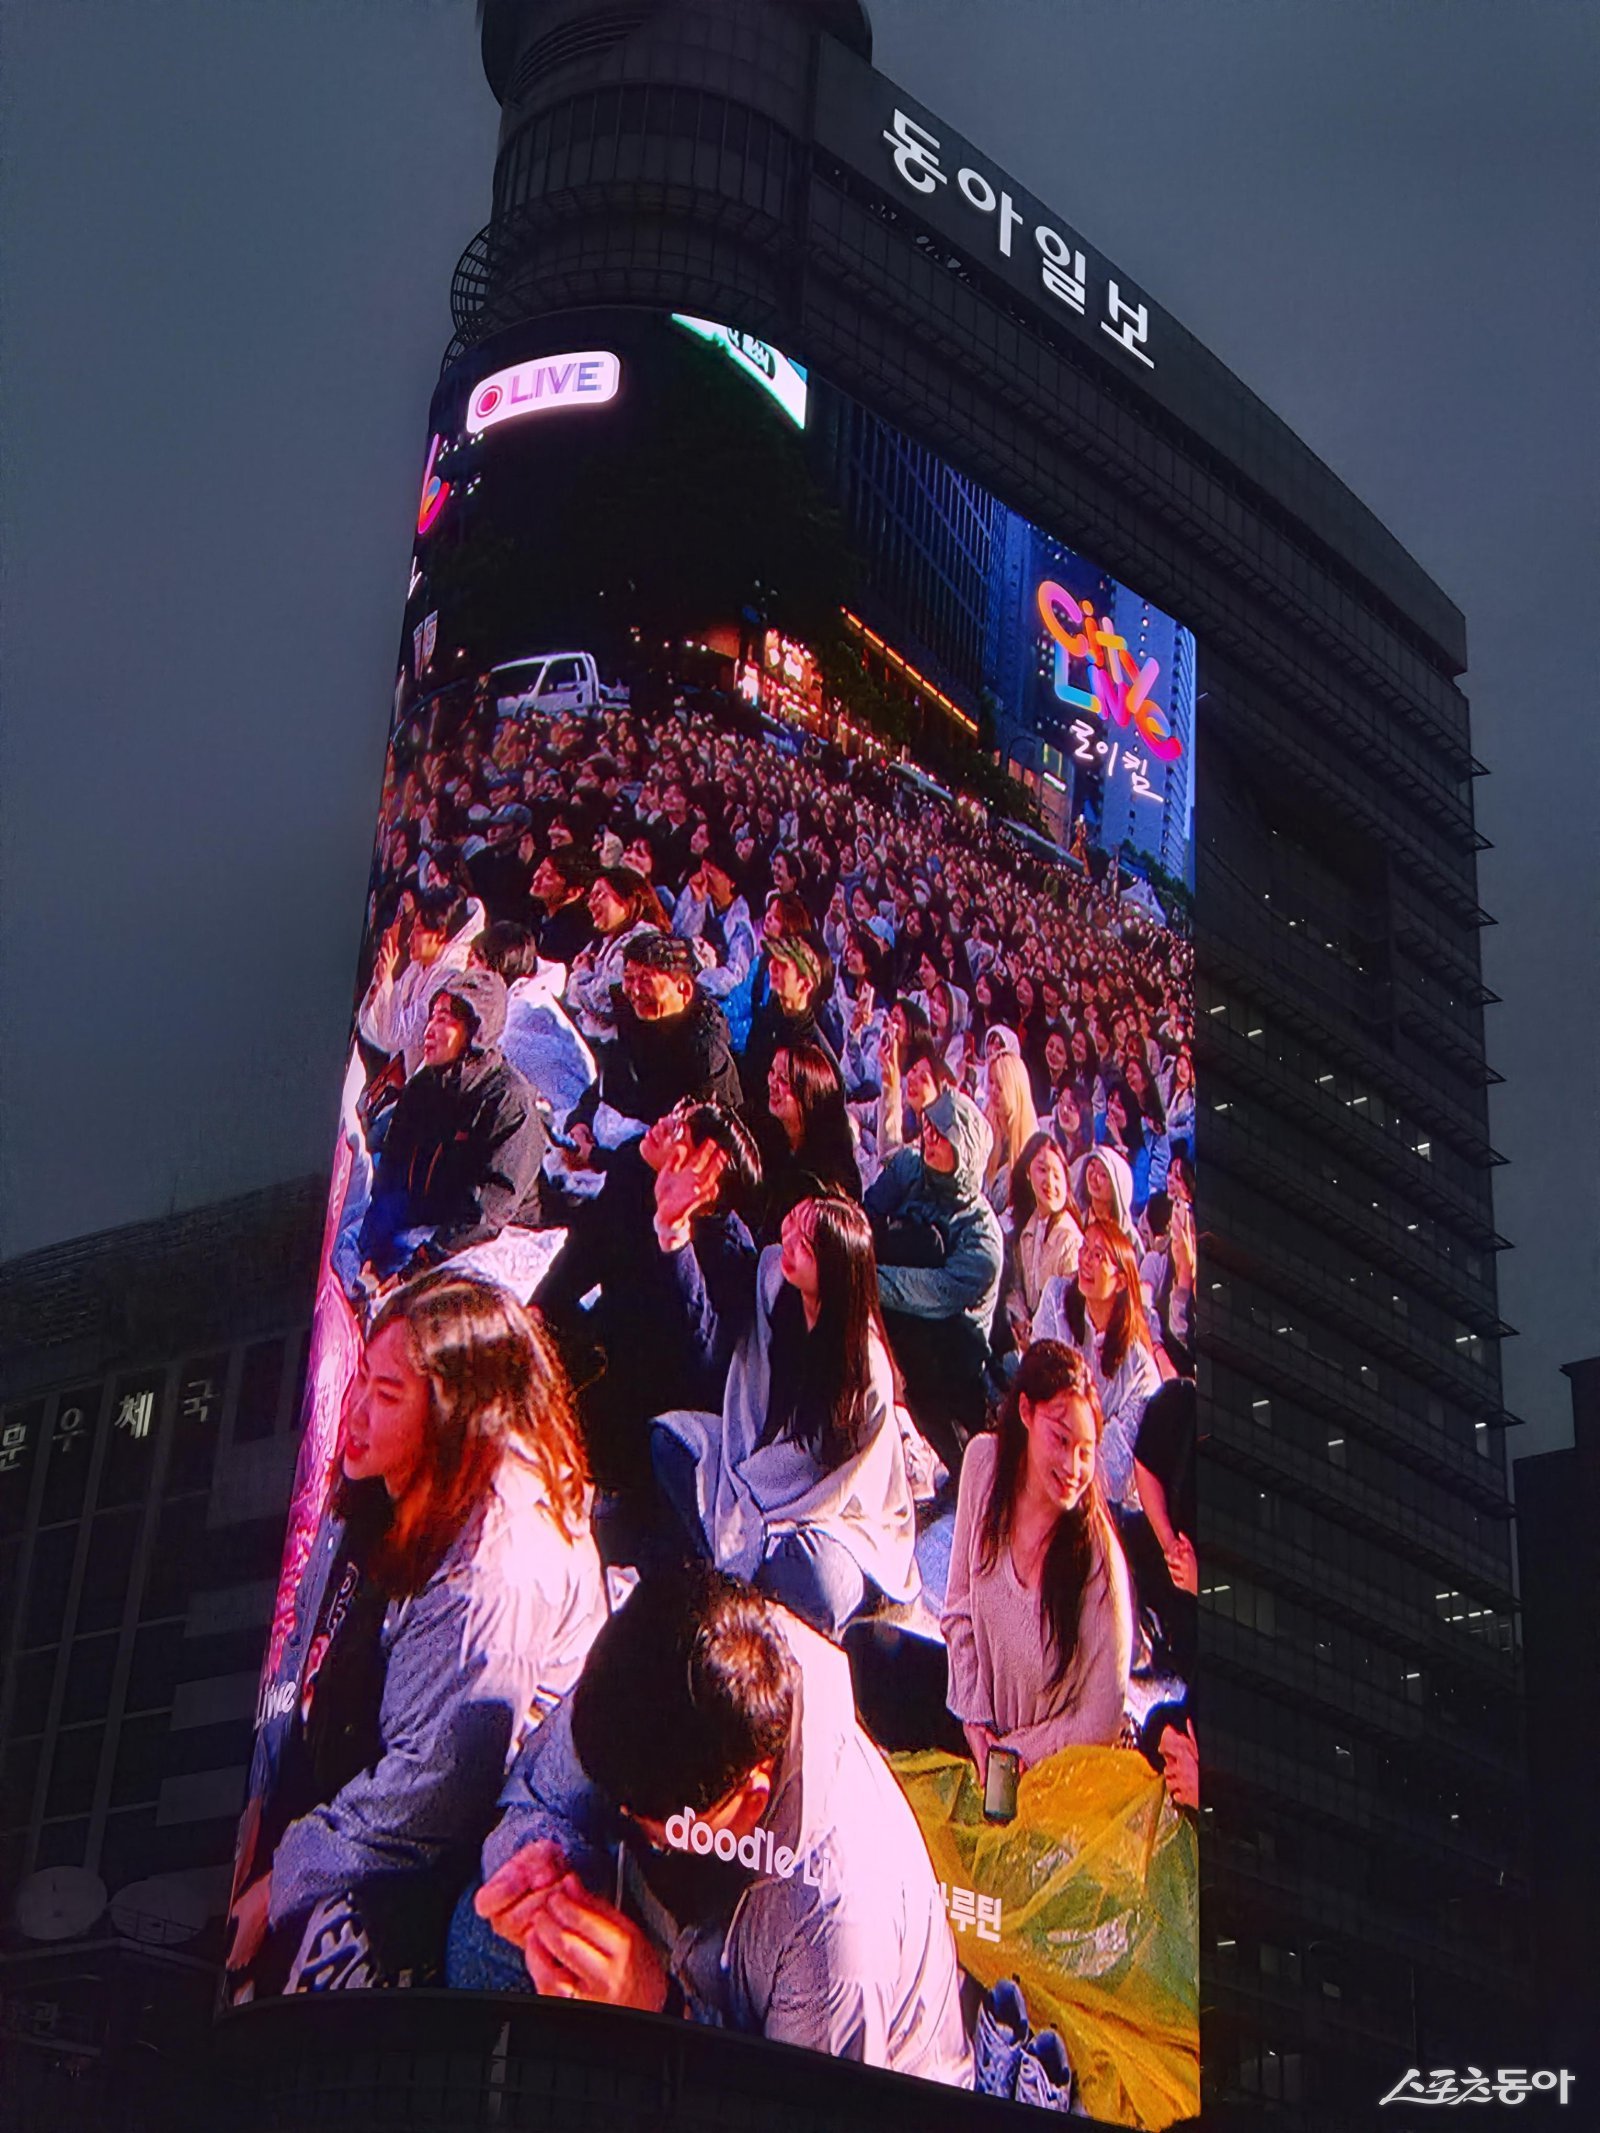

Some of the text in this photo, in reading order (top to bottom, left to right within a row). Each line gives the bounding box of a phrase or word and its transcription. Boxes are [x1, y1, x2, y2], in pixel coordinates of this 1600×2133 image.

[883, 108, 1154, 369] 동아일보
[510, 361, 604, 405] LIVE
[1069, 718, 1164, 802] 로이킴
[665, 1806, 795, 1879] doodle
